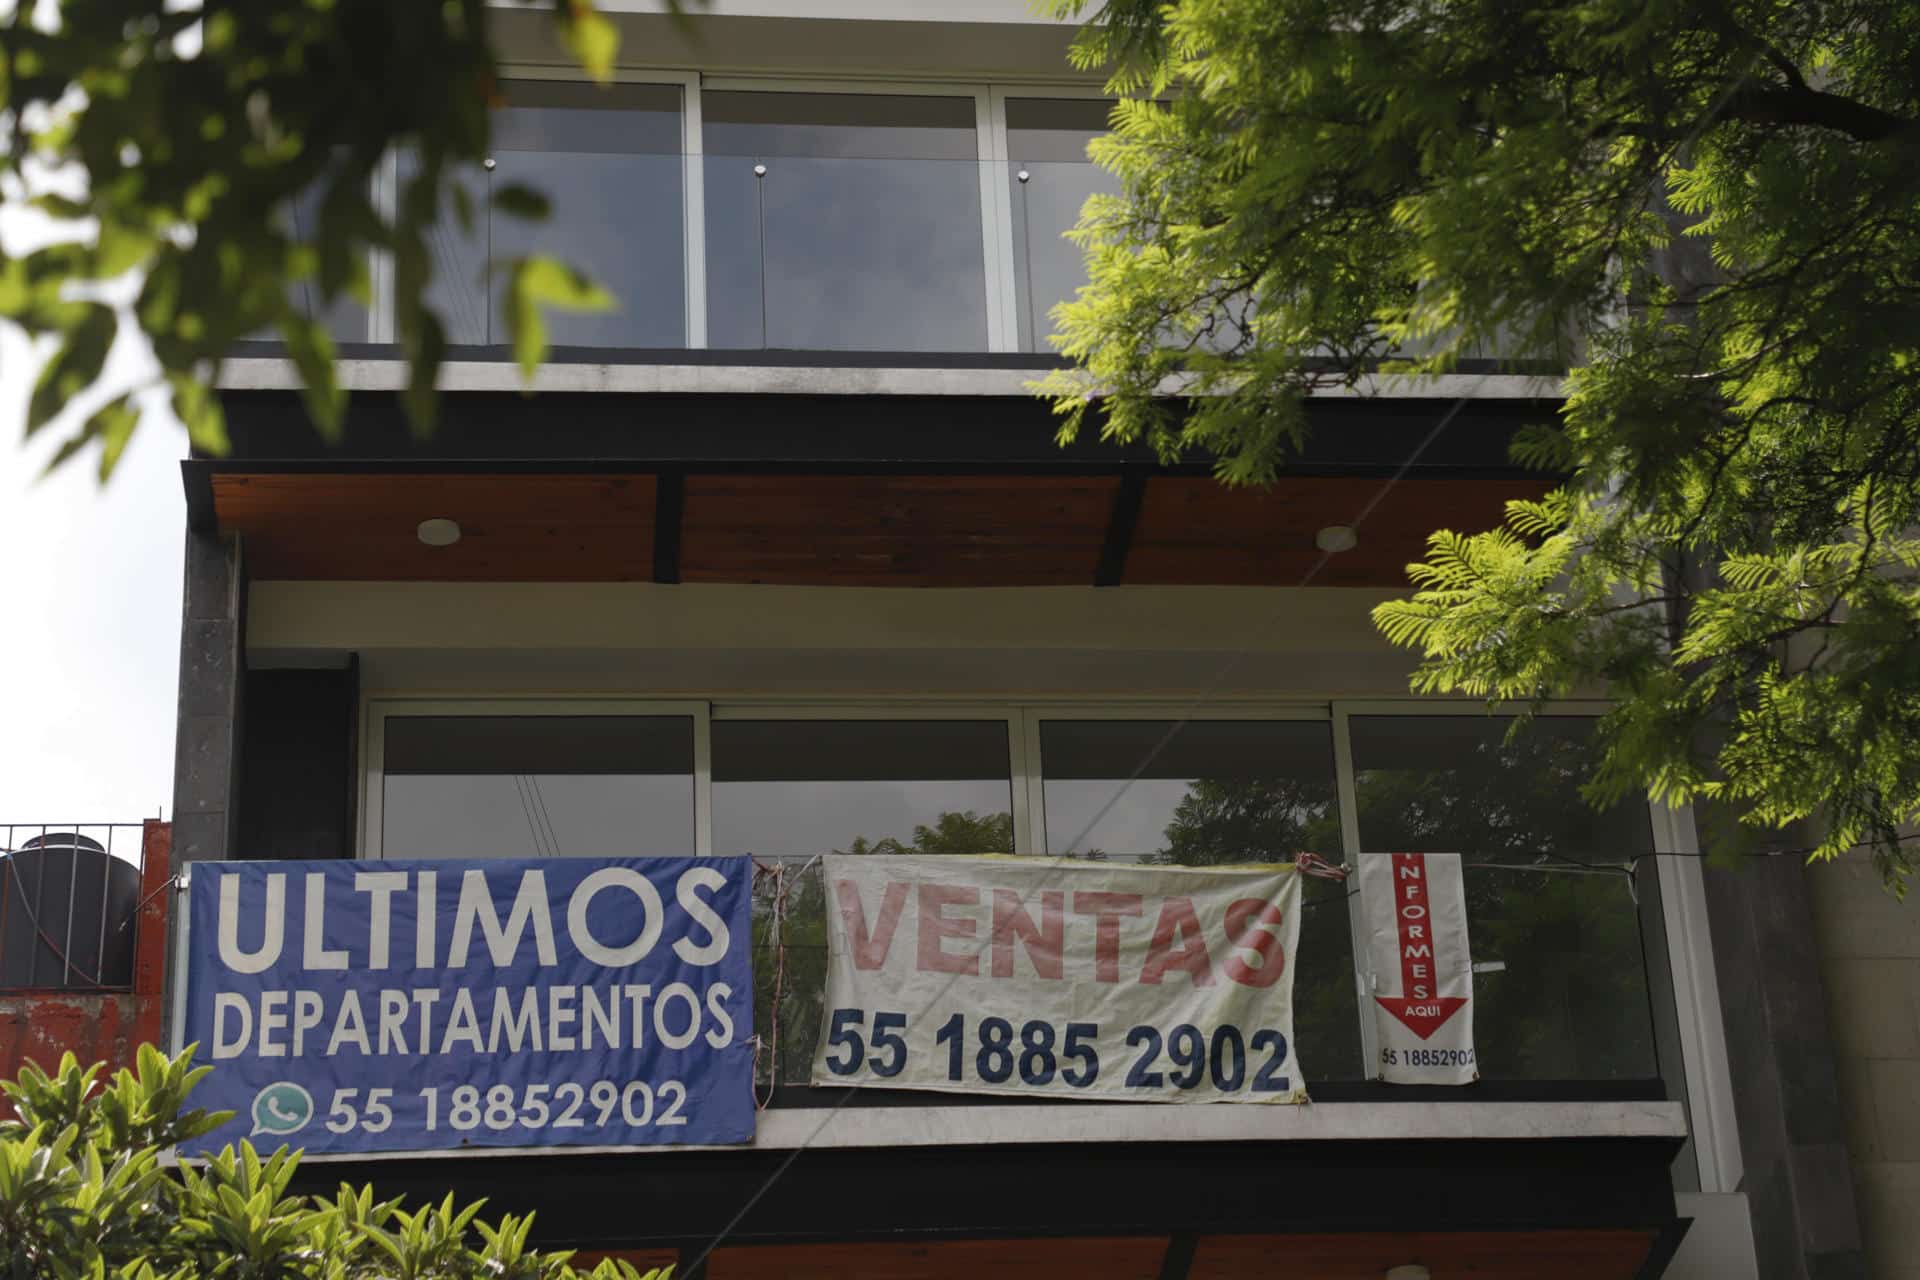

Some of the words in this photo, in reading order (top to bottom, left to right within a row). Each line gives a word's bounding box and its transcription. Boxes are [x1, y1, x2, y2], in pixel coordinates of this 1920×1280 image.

[217, 867, 731, 974] ULTIMOS
[834, 879, 1286, 989] VENTAS
[212, 982, 735, 1060] DEPARTAMENTOS
[825, 1008, 908, 1077] 55
[935, 1012, 1100, 1088] 1885
[1124, 1023, 1291, 1093] 2902
[1405, 1006, 1441, 1018] AQUI
[1382, 1048, 1398, 1065] 55
[326, 1087, 394, 1133] 55
[418, 1080, 688, 1132] 18852902
